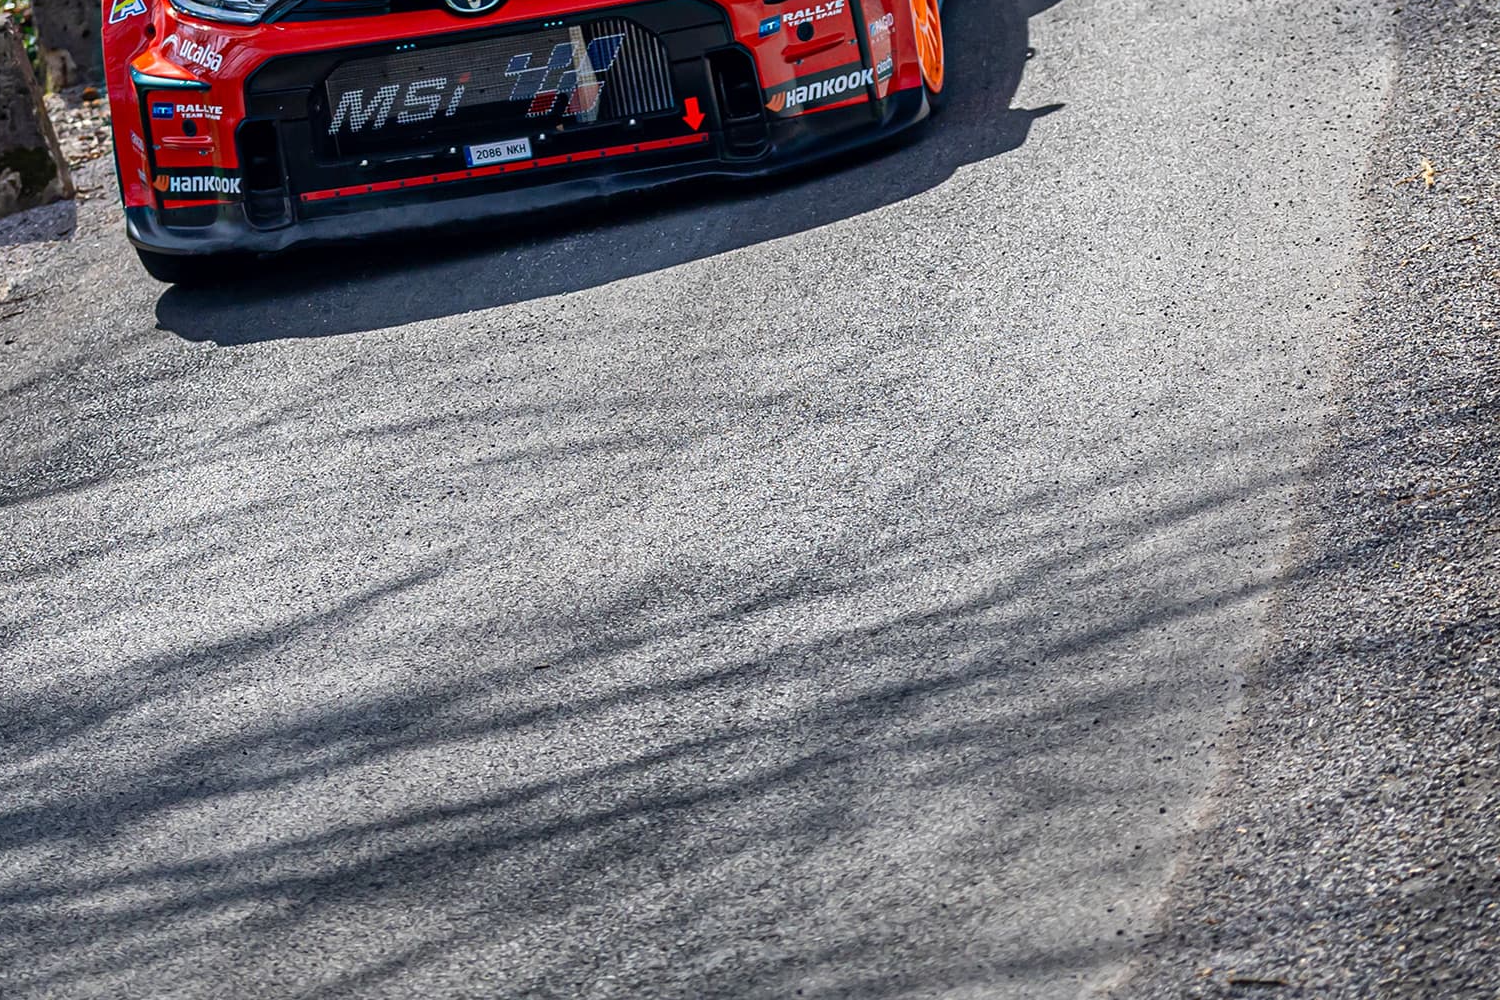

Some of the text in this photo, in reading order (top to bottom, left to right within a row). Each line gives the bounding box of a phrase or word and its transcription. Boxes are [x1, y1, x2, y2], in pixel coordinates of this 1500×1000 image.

[179, 38, 223, 72] ucalsa
[176, 103, 223, 115] RALLYE
[476, 143, 527, 160] 2086 NKH
